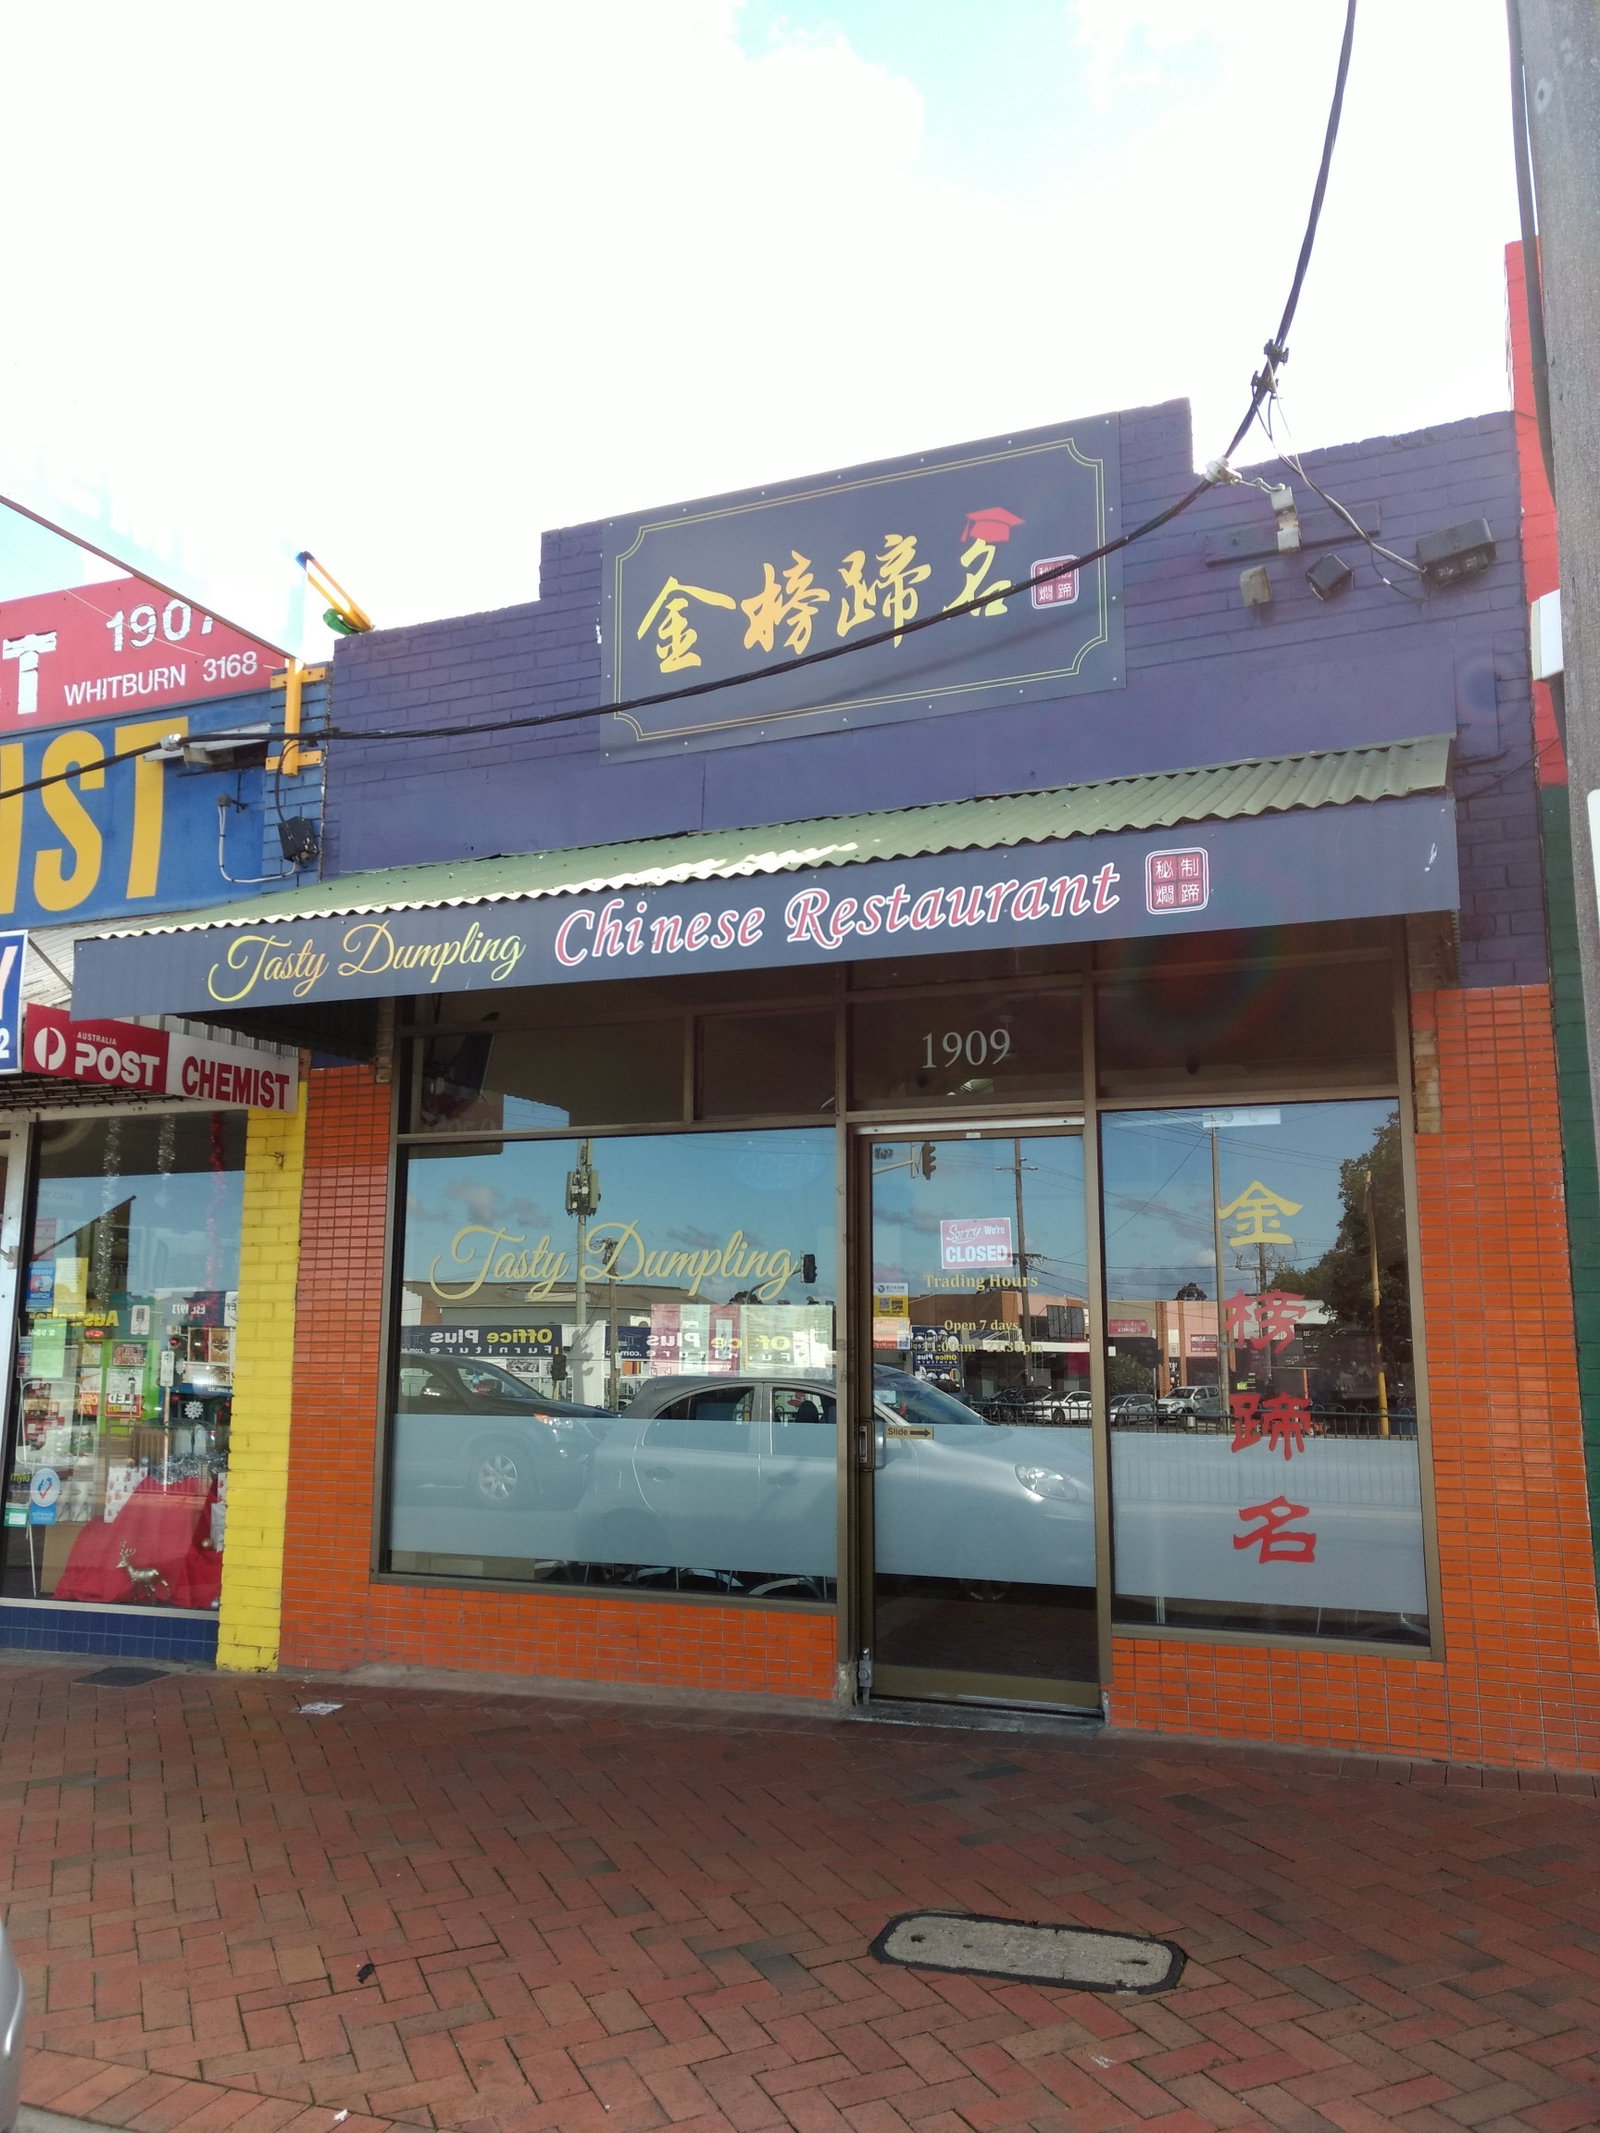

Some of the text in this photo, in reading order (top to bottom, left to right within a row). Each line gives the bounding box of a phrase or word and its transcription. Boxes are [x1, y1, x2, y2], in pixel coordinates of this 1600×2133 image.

[64, 650, 258, 706] WHITBURN 3168
[208, 862, 1121, 1003] Tasty Dumpling Chinese Restaurant
[76, 1031, 117, 1046] AUSTRALIA
[921, 1027, 1012, 1070] 1909
[74, 1044, 290, 1111] POST CHEMIST
[945, 1224, 1006, 1244] Sorry We're
[429, 1219, 804, 1302] Tasty Dumpling
[945, 1245, 1008, 1263] CLOSED
[923, 1273, 986, 1292] Trading
[989, 1273, 1039, 1288] Hours
[944, 1319, 1019, 1334] Open 7 days
[887, 1426, 909, 1436] Slide
